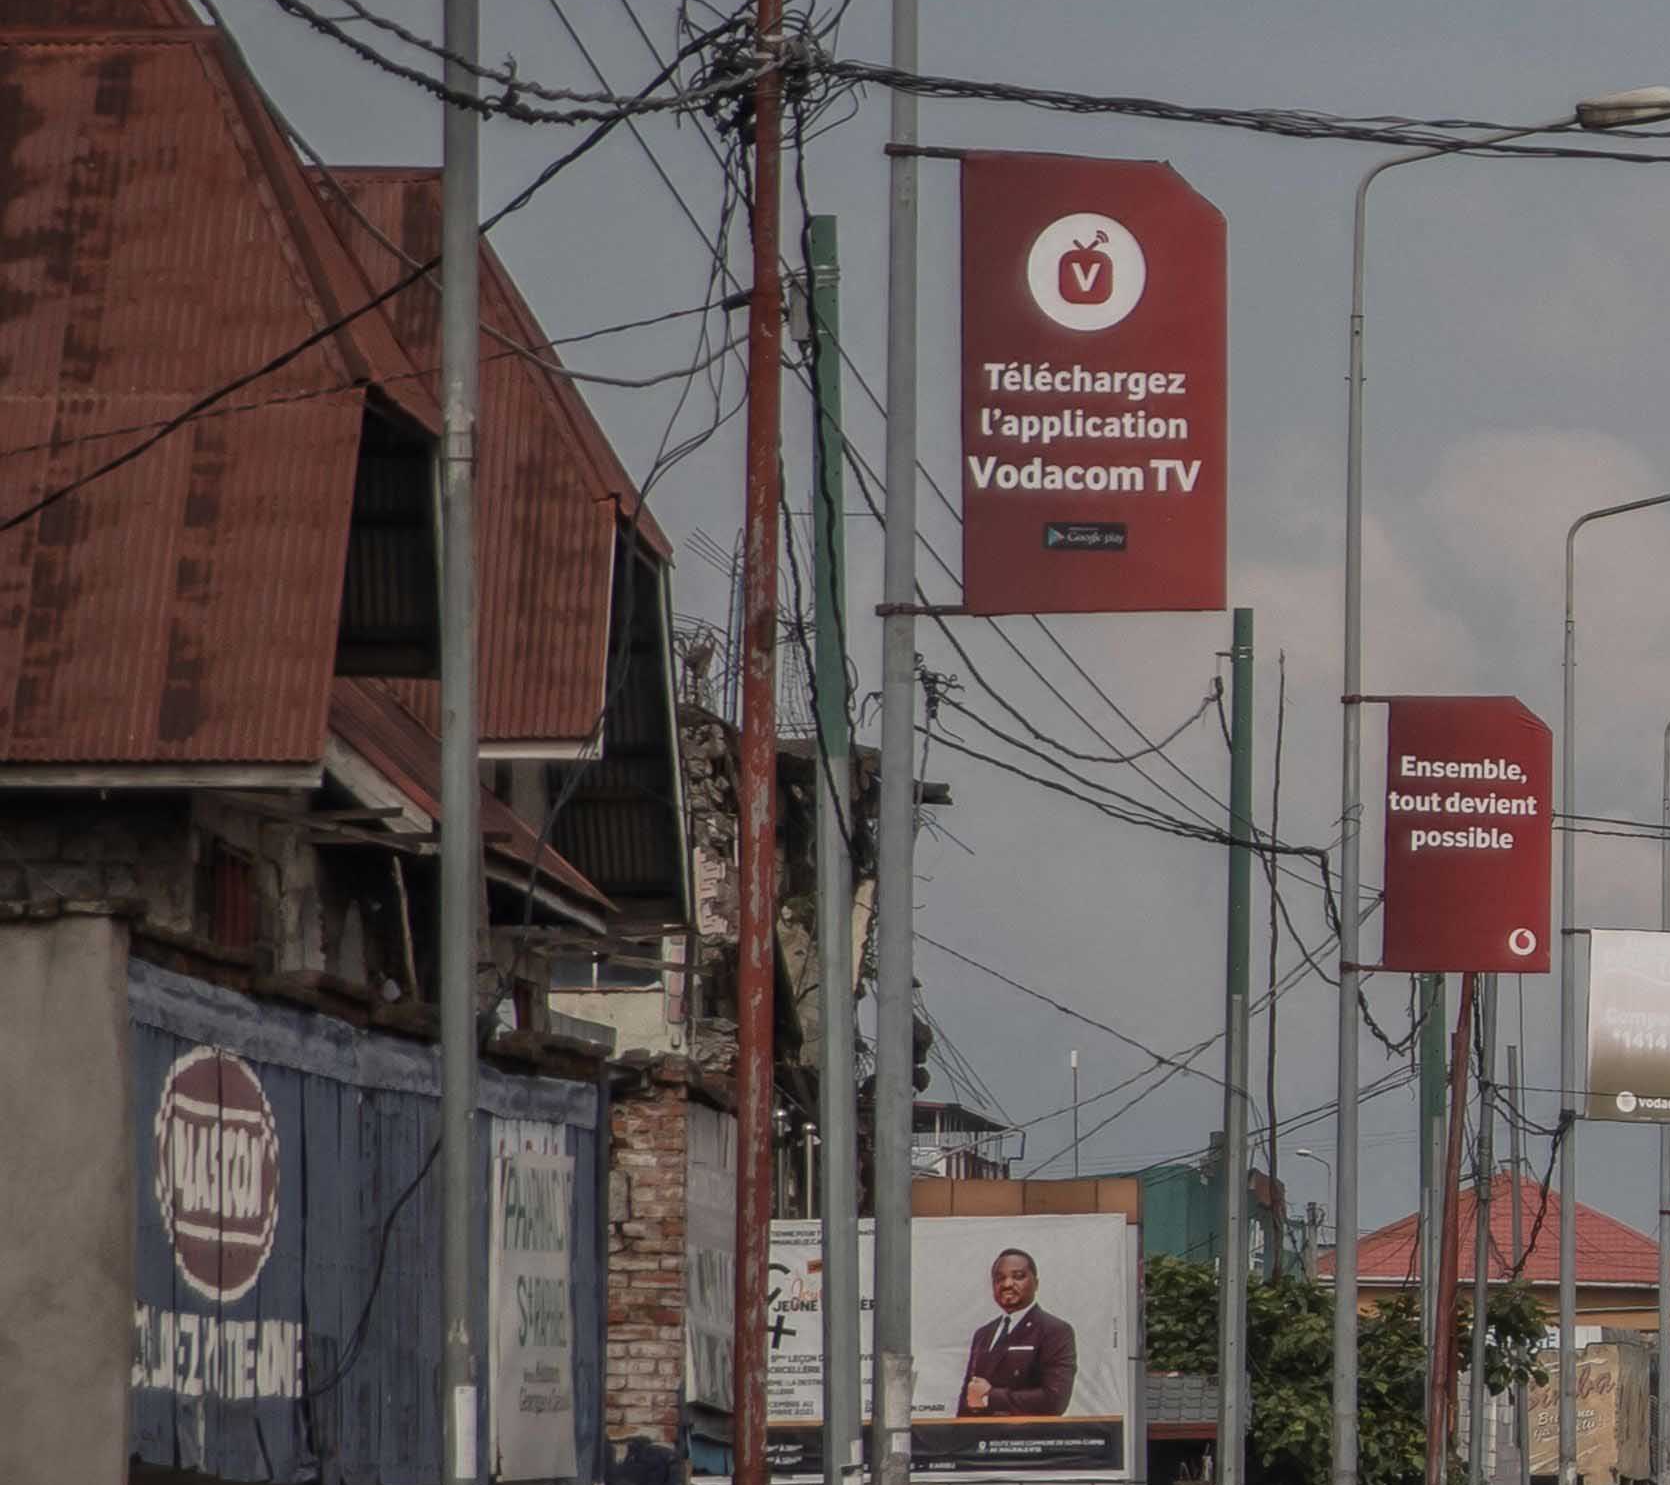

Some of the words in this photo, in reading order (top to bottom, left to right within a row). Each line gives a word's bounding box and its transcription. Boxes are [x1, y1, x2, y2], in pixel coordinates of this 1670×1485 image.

[984, 361, 1186, 401] Téléchargez
[981, 408, 1188, 444] l'application
[968, 456, 1144, 491] Vodacom
[1149, 459, 1202, 492] TV
[1401, 755, 1527, 784] Ensemble,
[1388, 791, 1442, 812] tout
[1445, 792, 1537, 815] devient
[1411, 826, 1514, 851] possible
